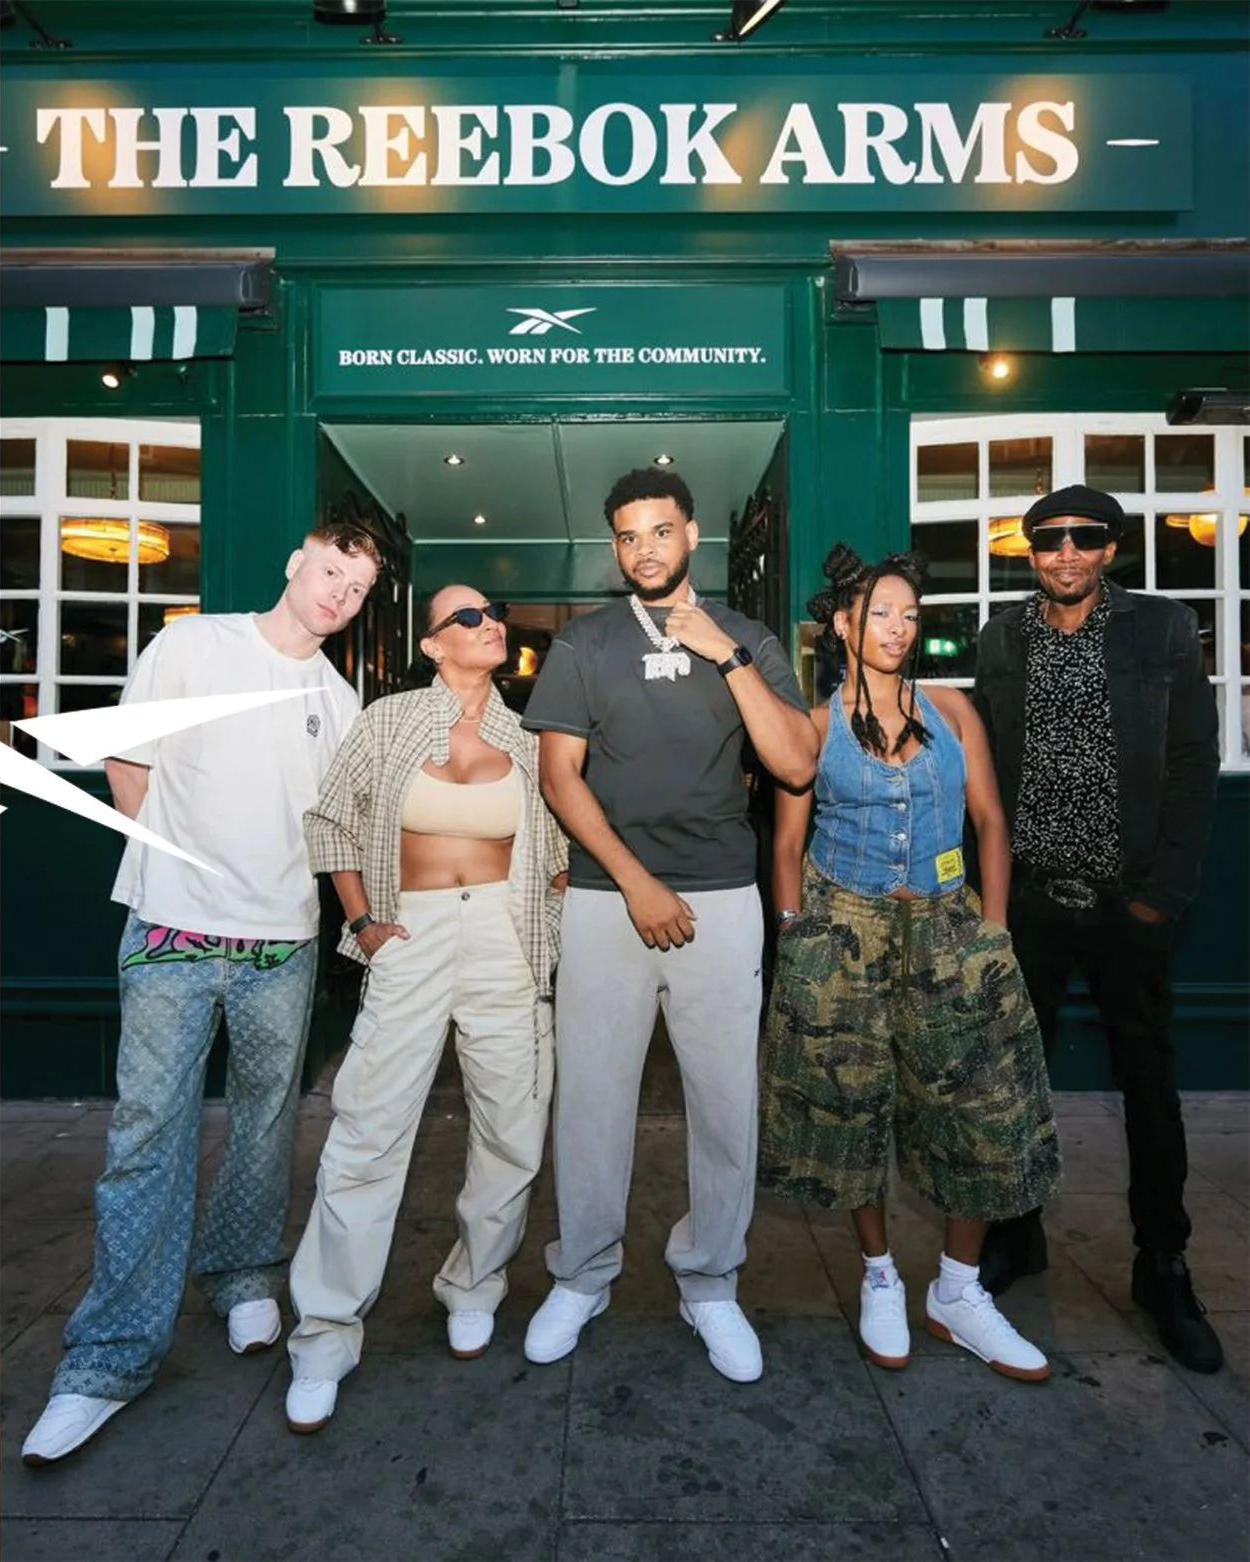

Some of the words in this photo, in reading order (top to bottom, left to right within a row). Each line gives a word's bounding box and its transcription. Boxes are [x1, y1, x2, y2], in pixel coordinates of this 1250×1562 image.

[36, 107, 258, 188] THE
[283, 102, 742, 188] REEBOK
[759, 100, 1080, 185] ARMS
[338, 349, 394, 366] BORN
[396, 348, 483, 366] CLASSIC.
[486, 348, 546, 365] WORN
[549, 348, 591, 364] FOR
[593, 347, 635, 364] THE
[638, 347, 767, 364] COMMUNITY.
